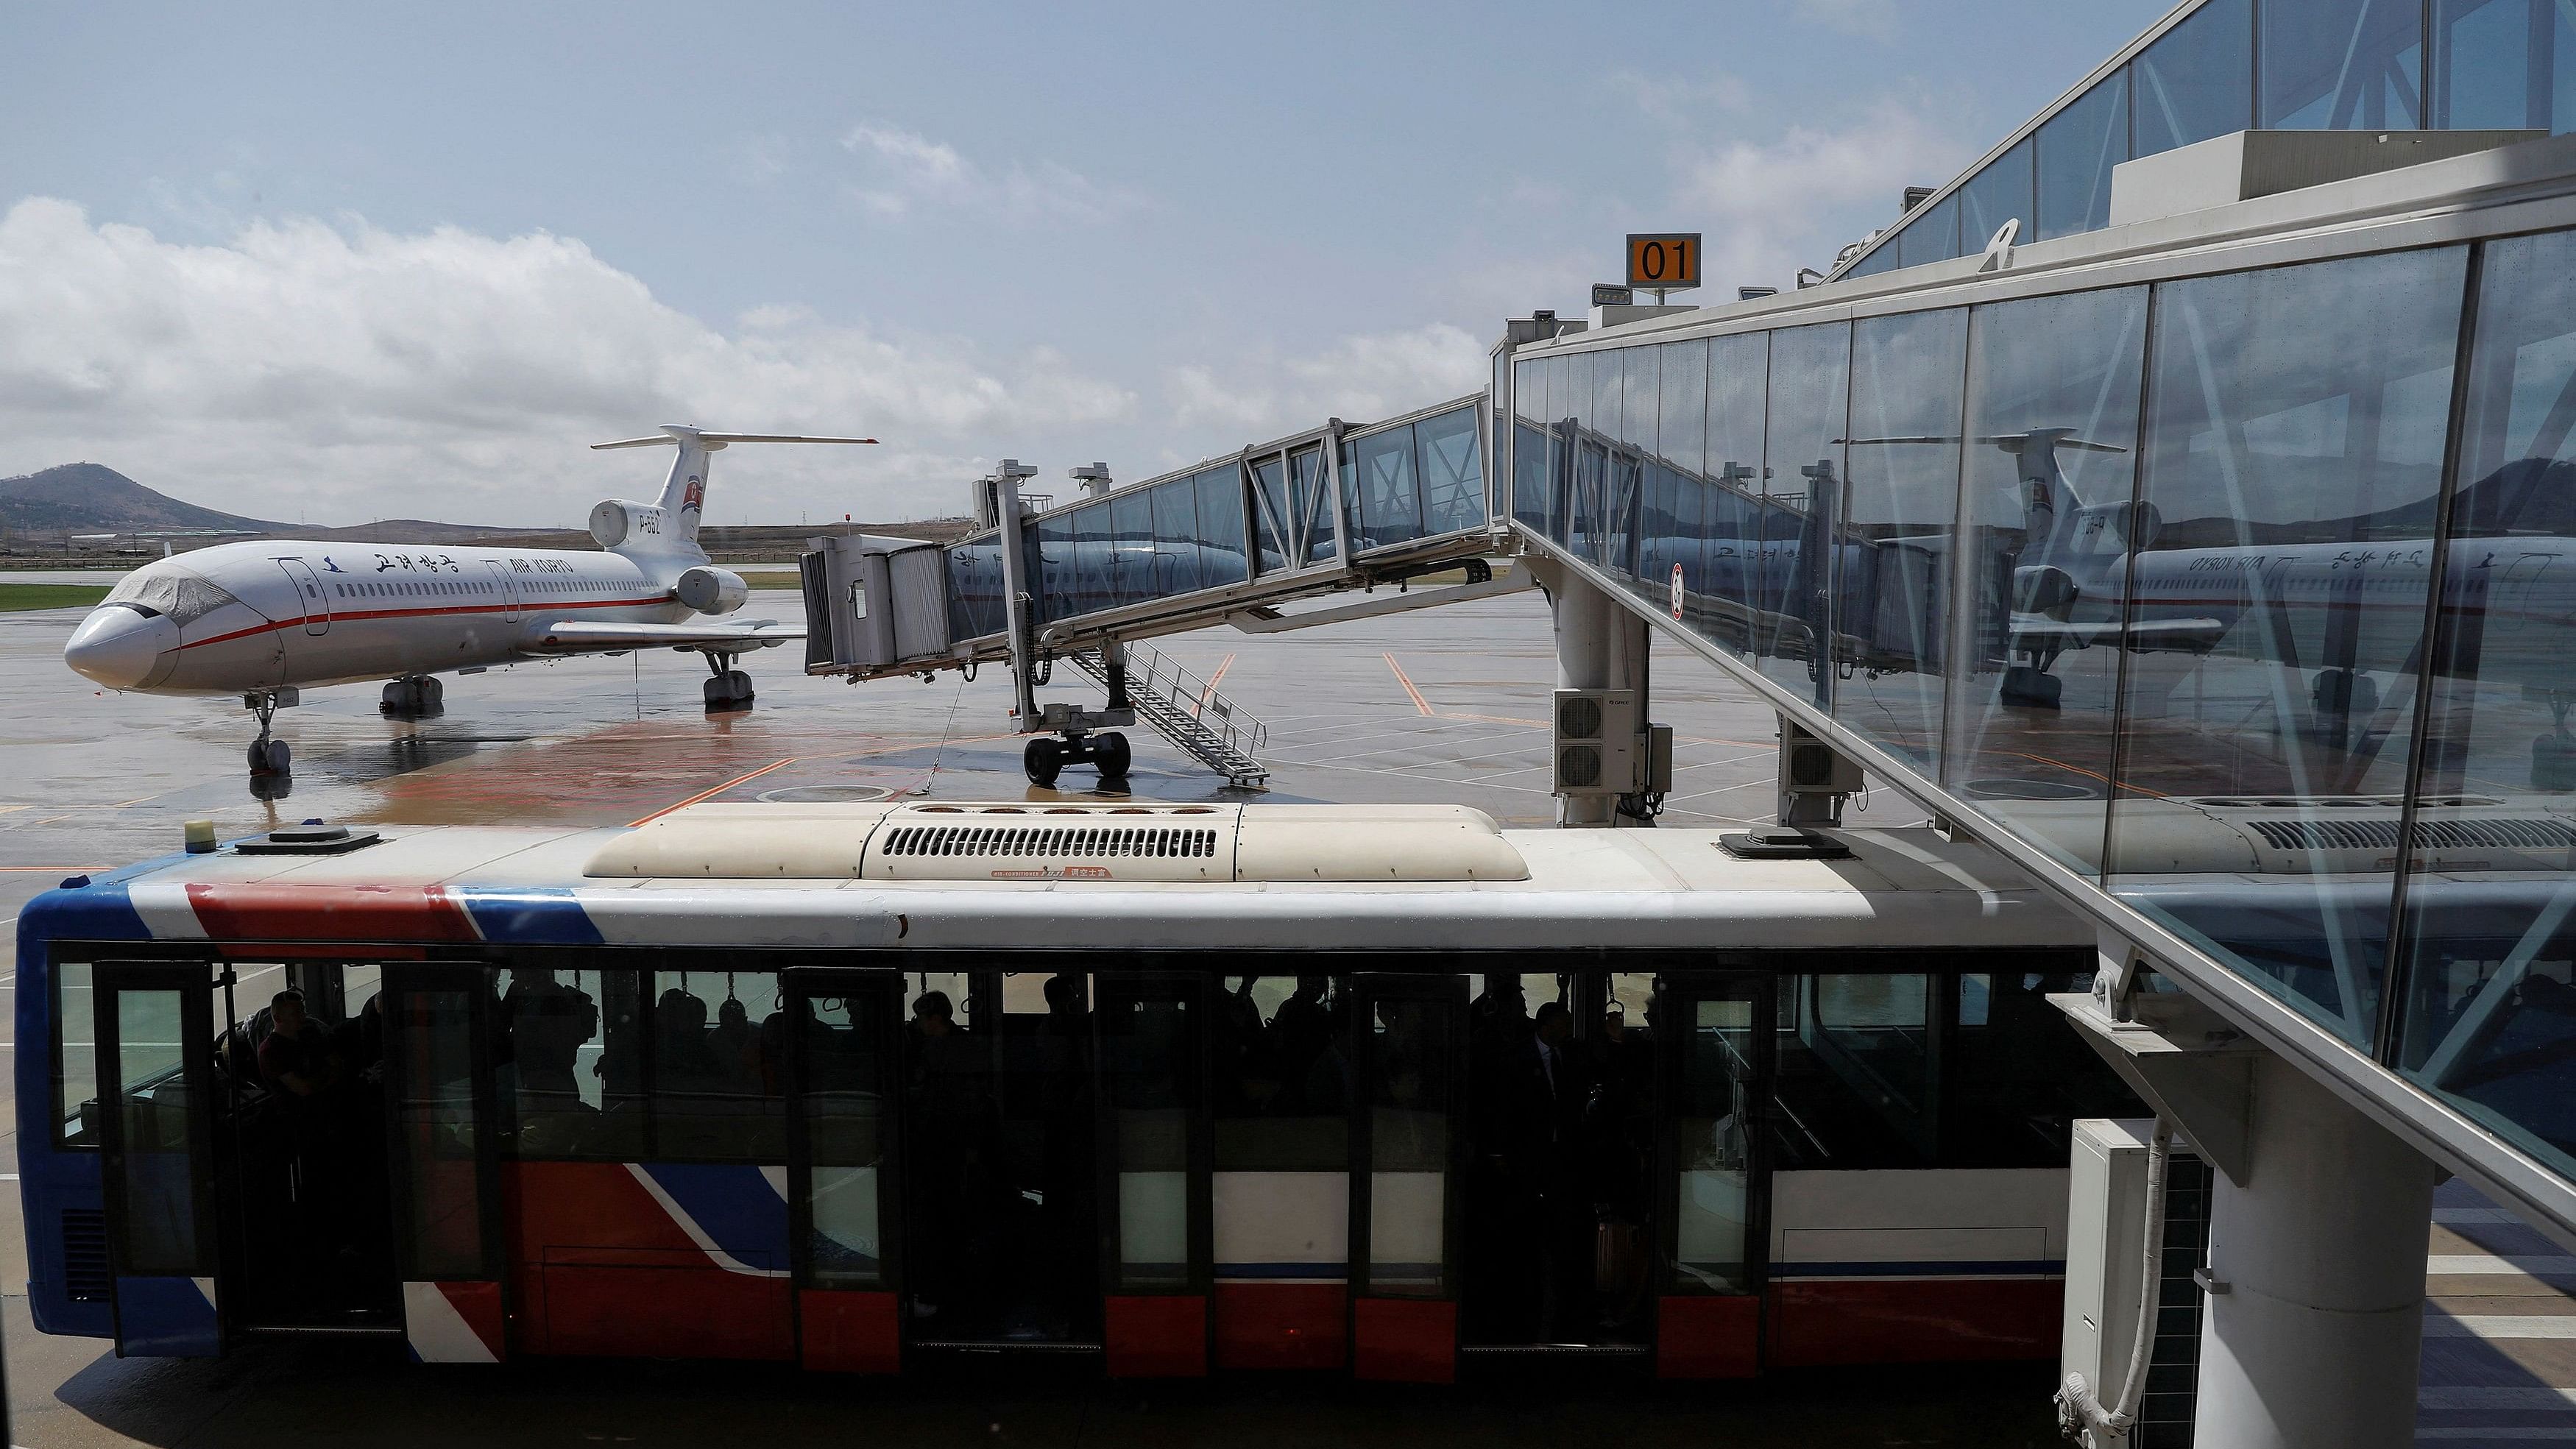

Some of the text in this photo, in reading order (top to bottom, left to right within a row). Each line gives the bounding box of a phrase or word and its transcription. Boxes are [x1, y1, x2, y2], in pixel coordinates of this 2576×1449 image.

[1641, 241, 1685, 280] 01
[639, 514, 660, 535] P-552
[509, 559, 574, 573] AIR KORYO
